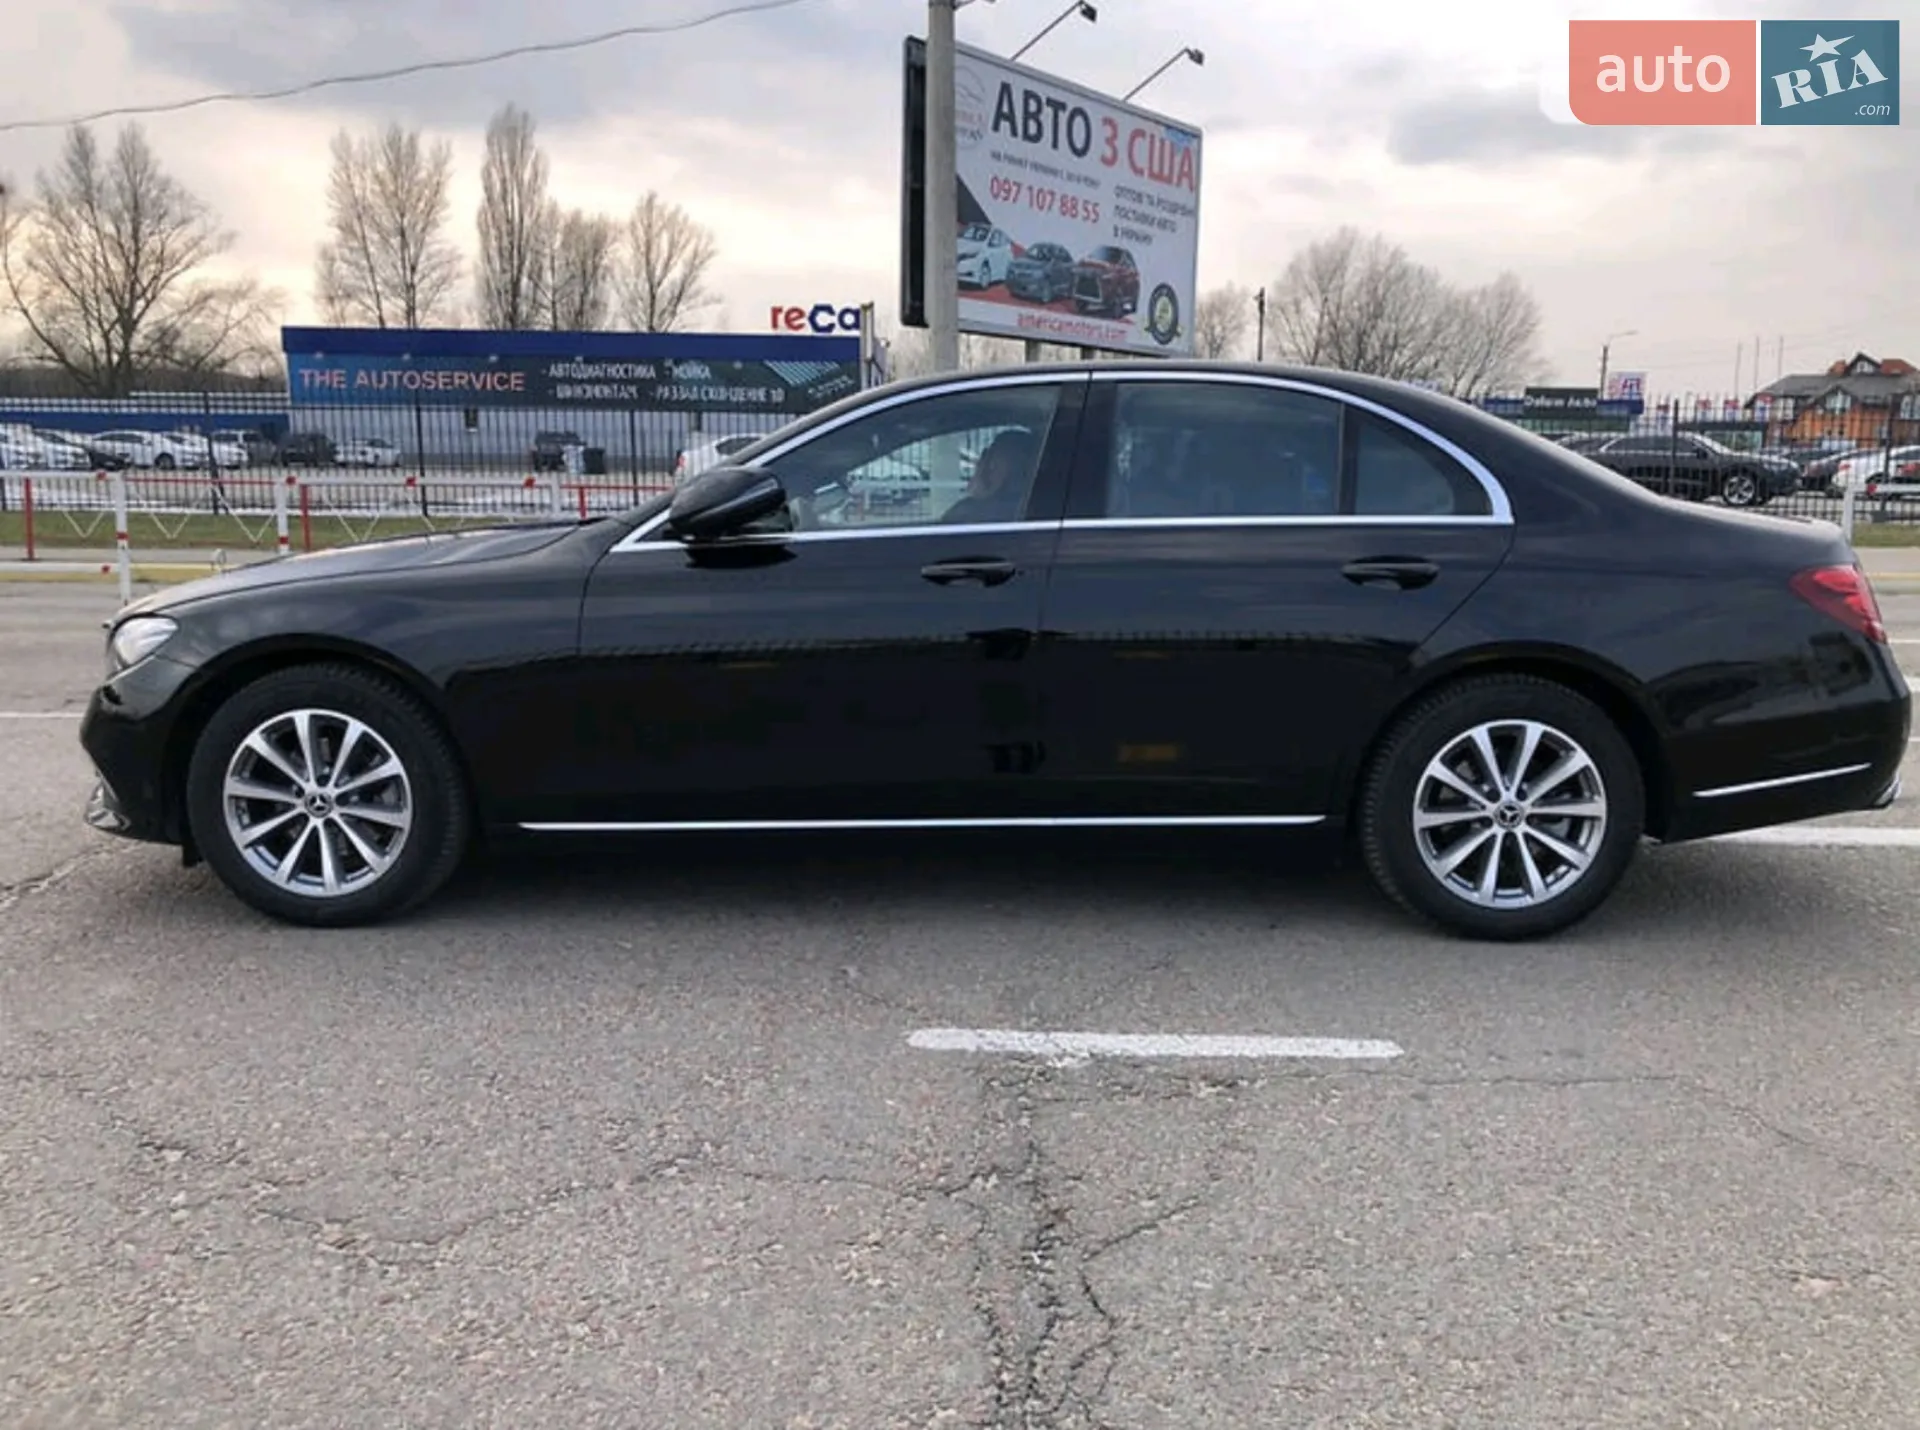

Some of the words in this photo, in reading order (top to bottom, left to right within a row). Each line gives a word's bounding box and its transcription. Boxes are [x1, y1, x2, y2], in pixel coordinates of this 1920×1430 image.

[991, 81, 1092, 158] АВТО
[1128, 128, 1195, 192] США
[990, 175, 1021, 204] 097
[1027, 185, 1057, 212] 107
[1059, 193, 1078, 219] 88
[1082, 200, 1100, 223] 55
[299, 368, 347, 389] THE
[354, 369, 526, 392] AUTOSERVICE
